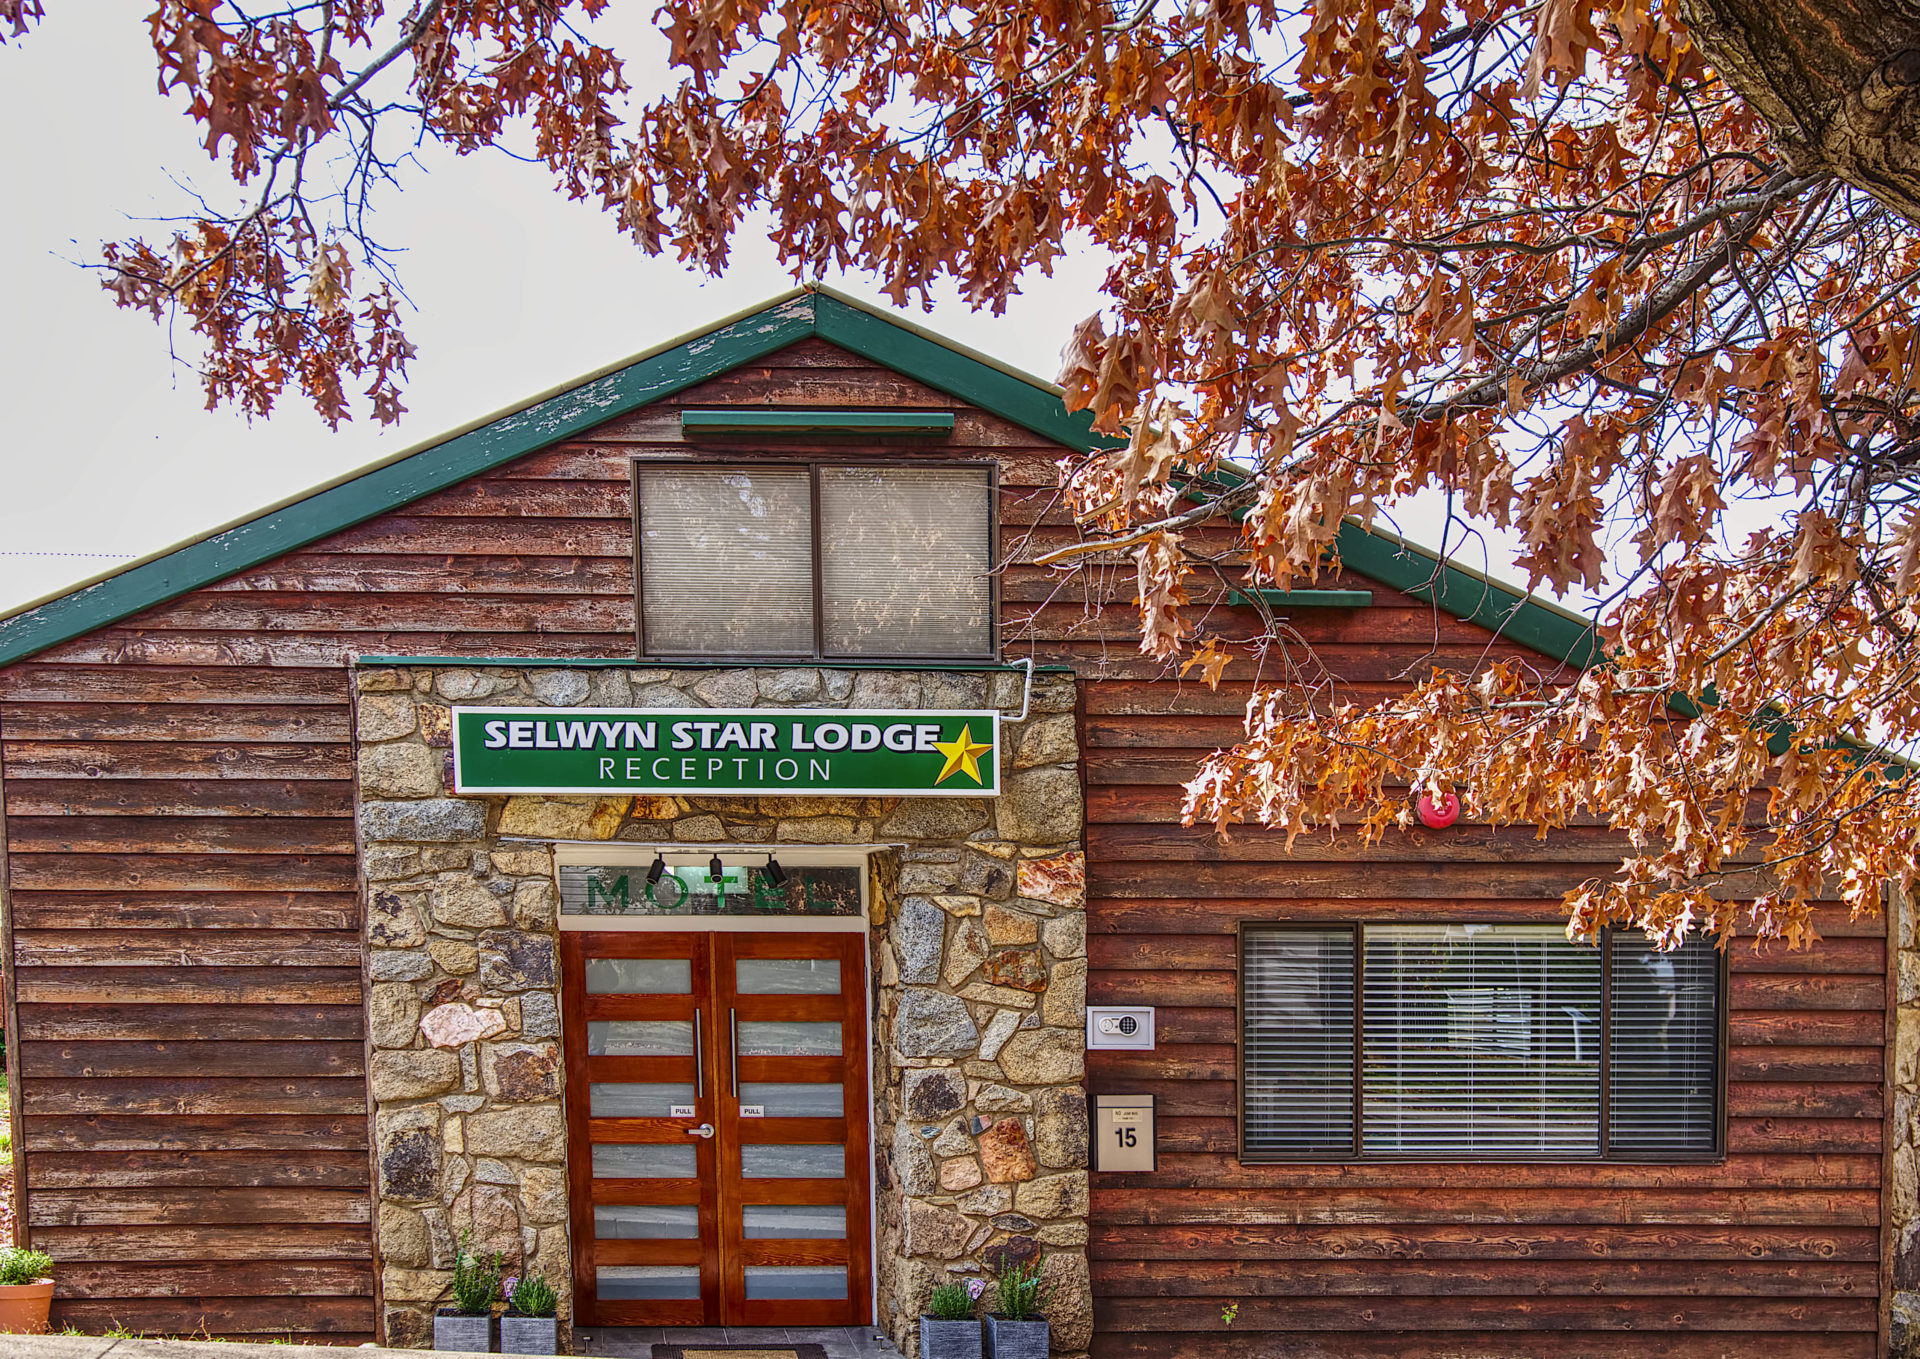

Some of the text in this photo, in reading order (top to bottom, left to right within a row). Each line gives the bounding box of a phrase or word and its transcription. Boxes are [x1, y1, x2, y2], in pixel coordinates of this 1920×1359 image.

[484, 721, 942, 753] SELWYN STAR LODGE
[600, 757, 830, 781] RECEPTION
[587, 874, 837, 909] MOTEL
[1114, 1127, 1137, 1148] 15
